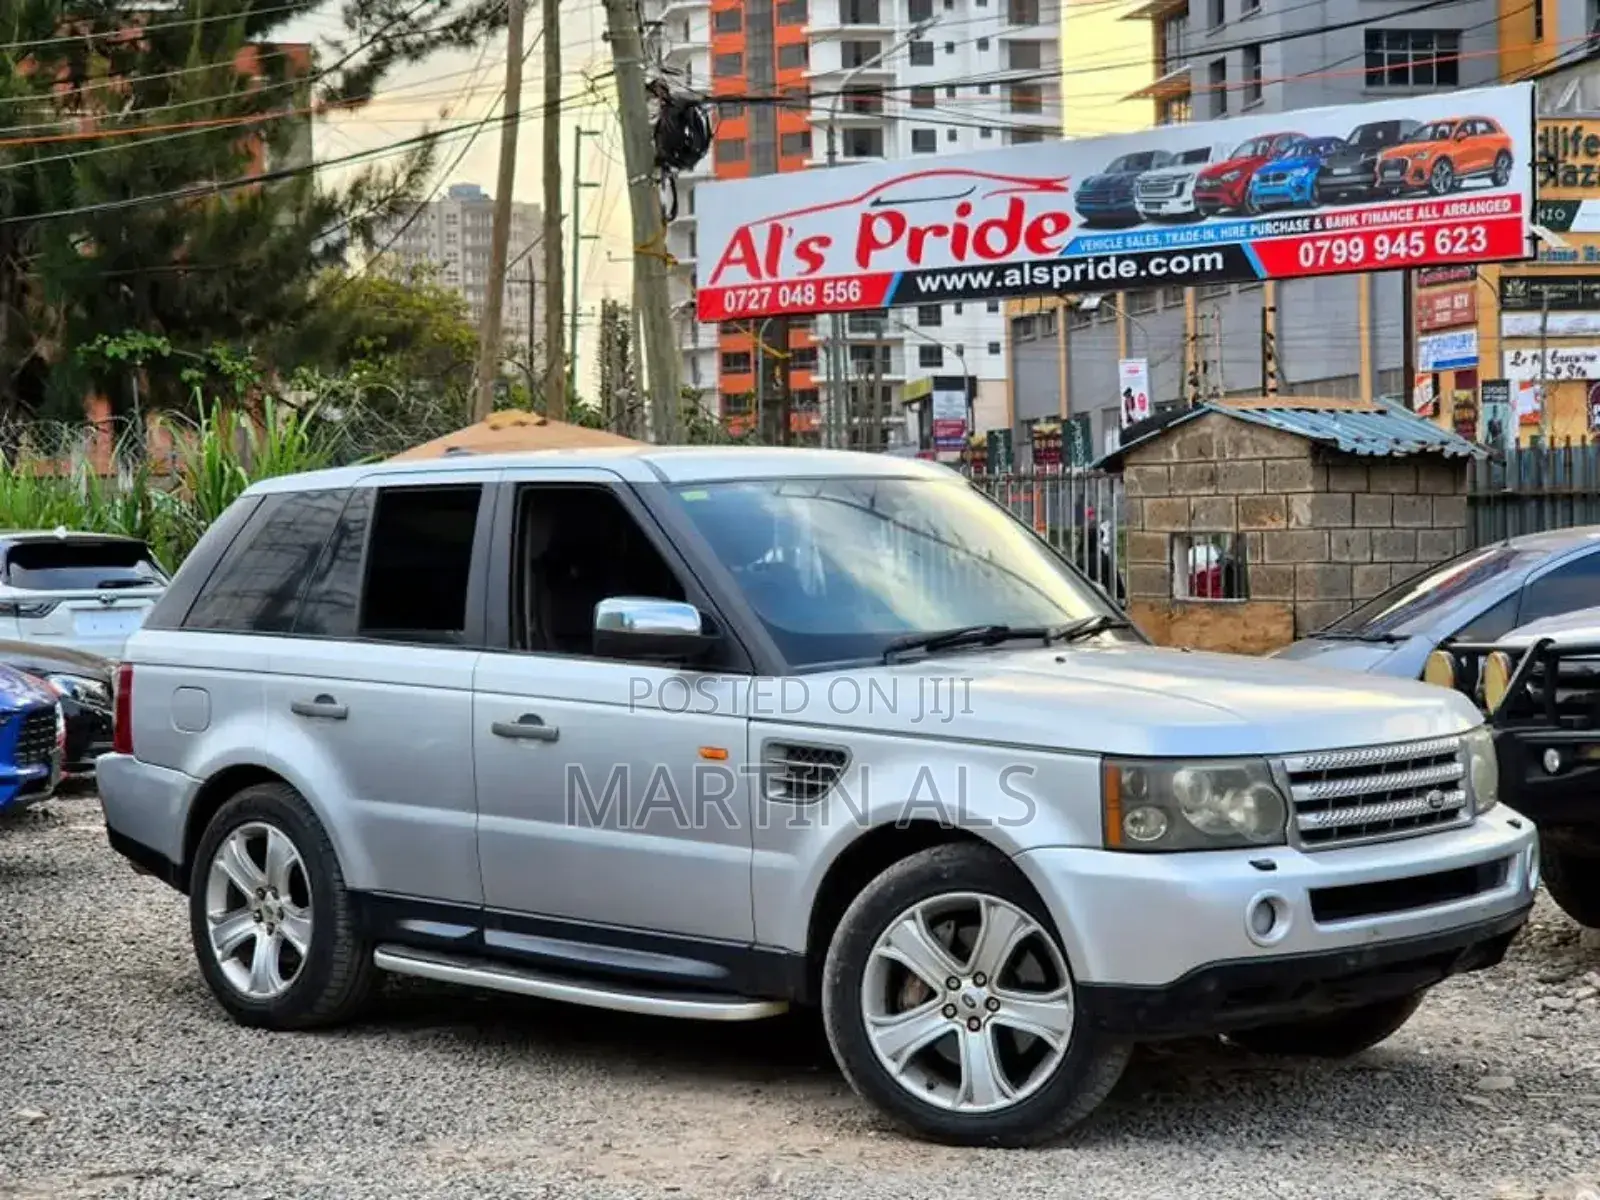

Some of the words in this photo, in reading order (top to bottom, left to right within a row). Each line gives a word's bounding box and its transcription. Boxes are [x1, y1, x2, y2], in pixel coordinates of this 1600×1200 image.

[708, 222, 833, 286] Al's
[855, 196, 1072, 270] Pride
[1079, 238, 1125, 252] VEHICLE
[1126, 232, 1161, 247] SALES,
[1164, 227, 1219, 245] TRADE-IN,
[1220, 224, 1247, 239] HIRE
[1249, 216, 1311, 236] PURCHASE
[1313, 217, 1323, 230] &
[1325, 212, 1361, 229] BANK
[1361, 205, 1414, 225] FINANCE
[1416, 203, 1440, 219] ALL
[1443, 198, 1512, 217] ARRANGED
[1298, 236, 1365, 268] 0799
[1373, 230, 1426, 261] 945
[1434, 224, 1488, 255] 623
[916, 252, 1225, 294] www.alspride.com
[724, 286, 773, 313] 0727
[778, 284, 817, 309] 048
[822, 280, 862, 304] 556
